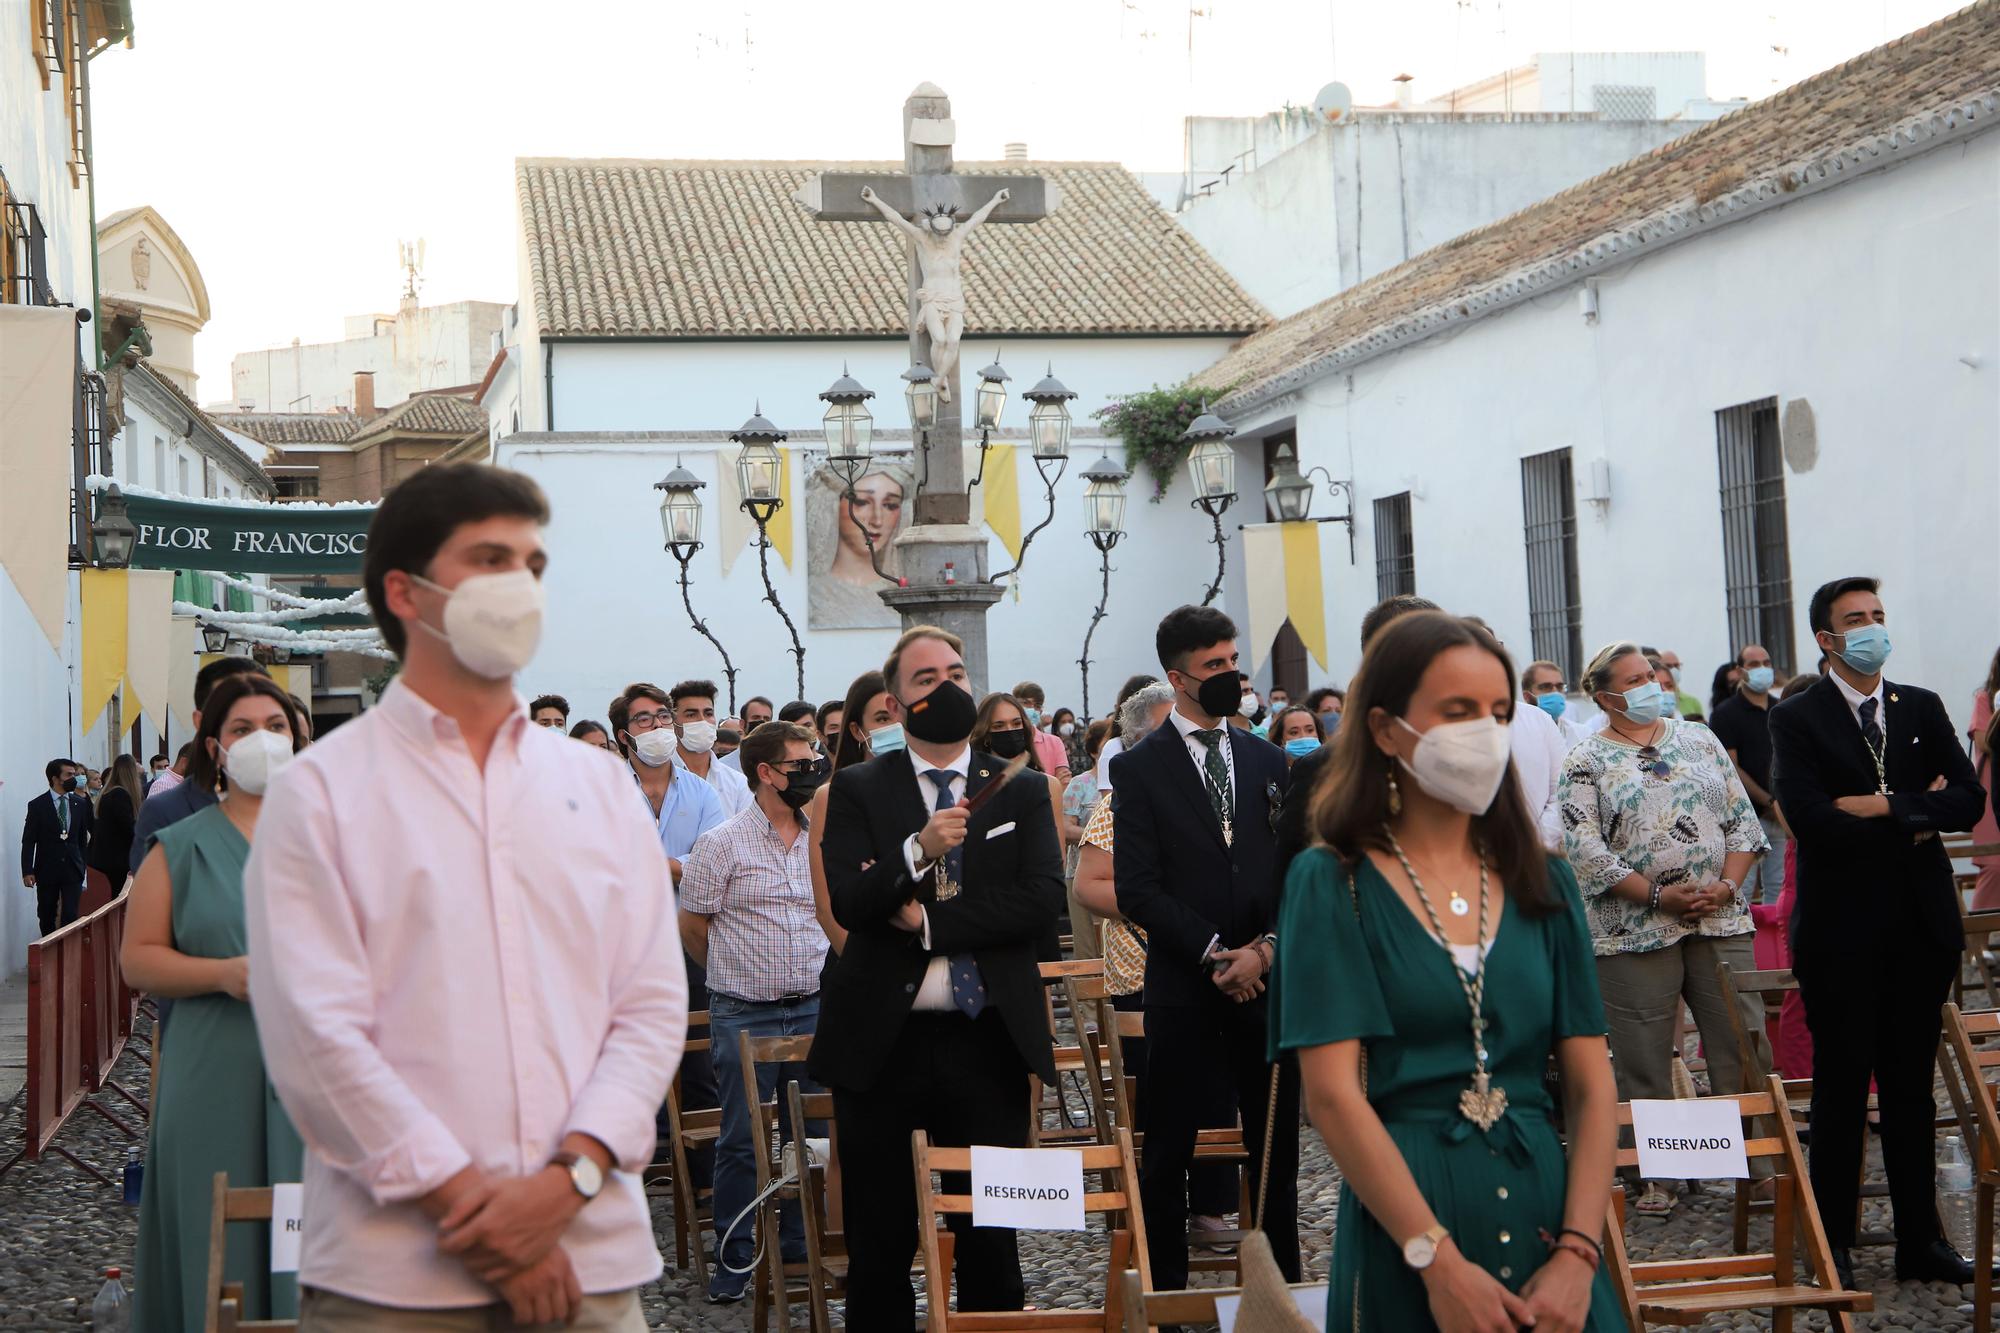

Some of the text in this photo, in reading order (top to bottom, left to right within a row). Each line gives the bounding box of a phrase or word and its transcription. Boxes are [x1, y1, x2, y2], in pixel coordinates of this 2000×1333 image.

[138, 524, 212, 550] FLOR
[1647, 1137, 1731, 1151] RESERVADO
[984, 1185, 1070, 1201] RESERVADO
